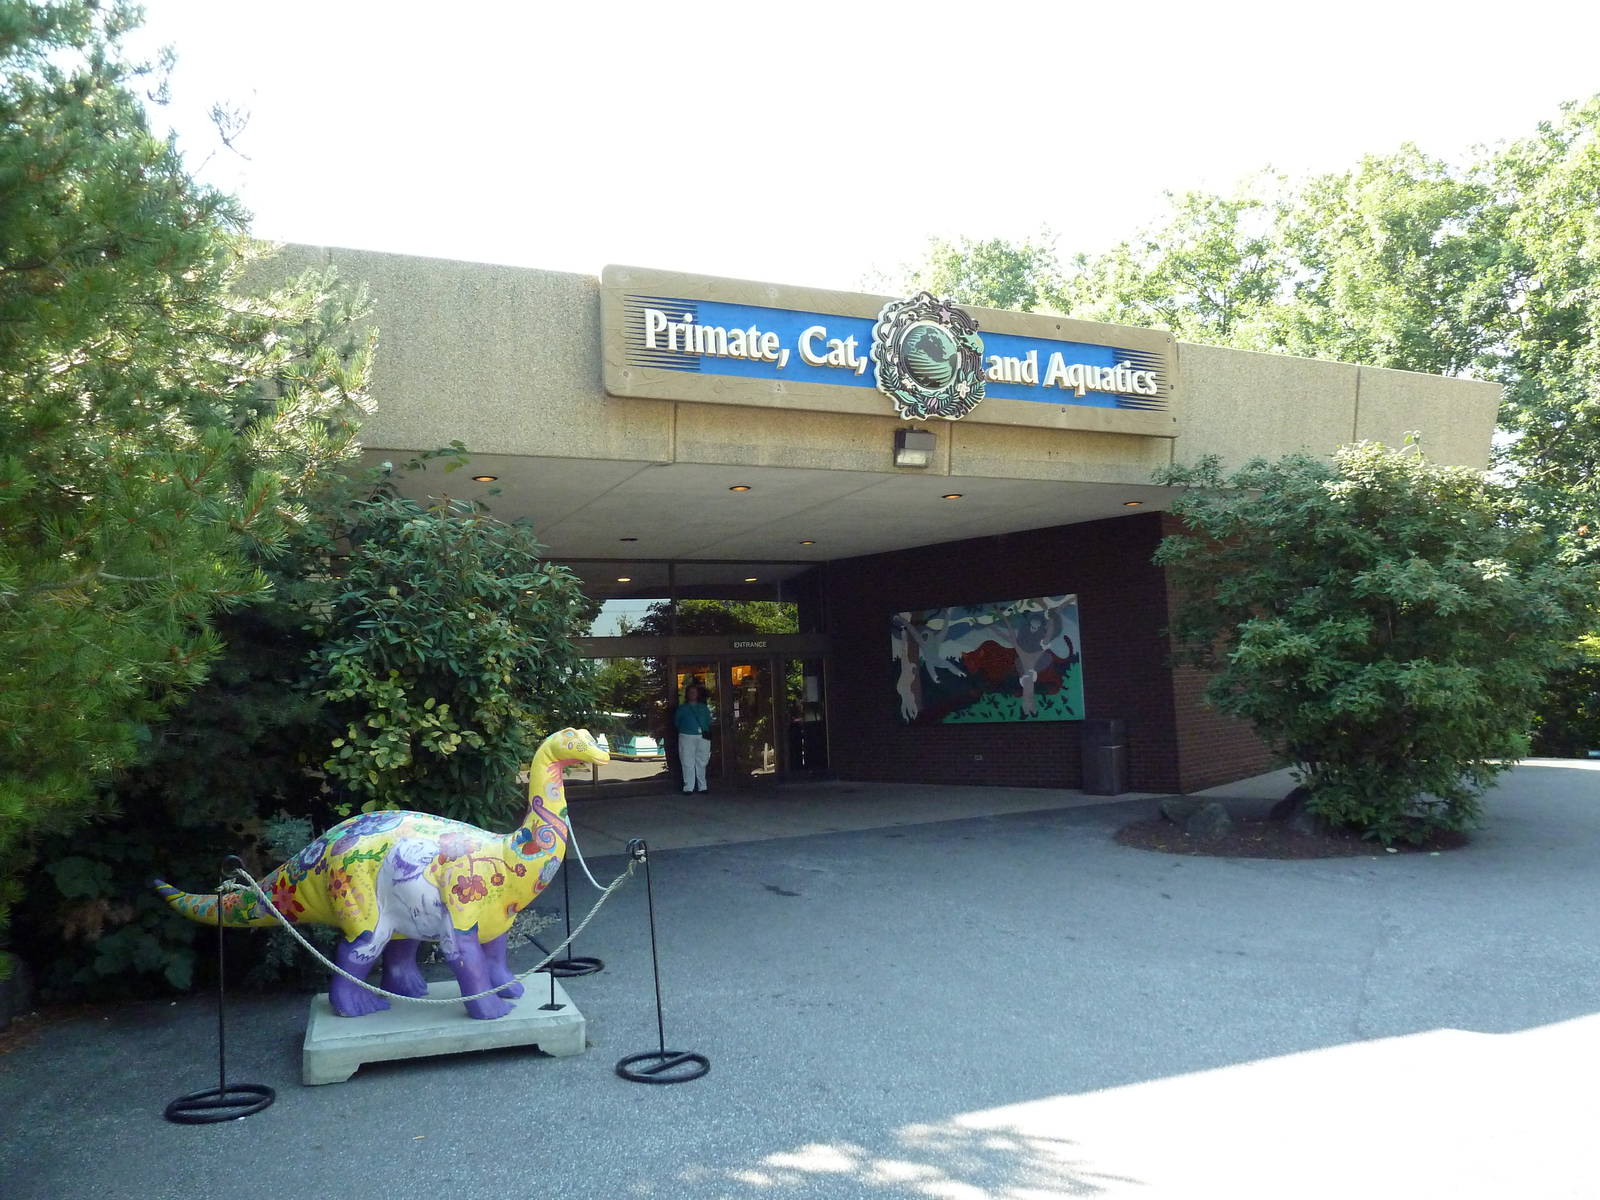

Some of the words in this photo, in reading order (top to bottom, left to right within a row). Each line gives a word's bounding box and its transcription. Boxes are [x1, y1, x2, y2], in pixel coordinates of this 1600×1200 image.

[644, 308, 790, 369] Primate,
[798, 325, 868, 375] Cat,
[985, 350, 1039, 386] and
[1042, 352, 1158, 397] Aquatics
[733, 641, 767, 649] ENTRANCE
